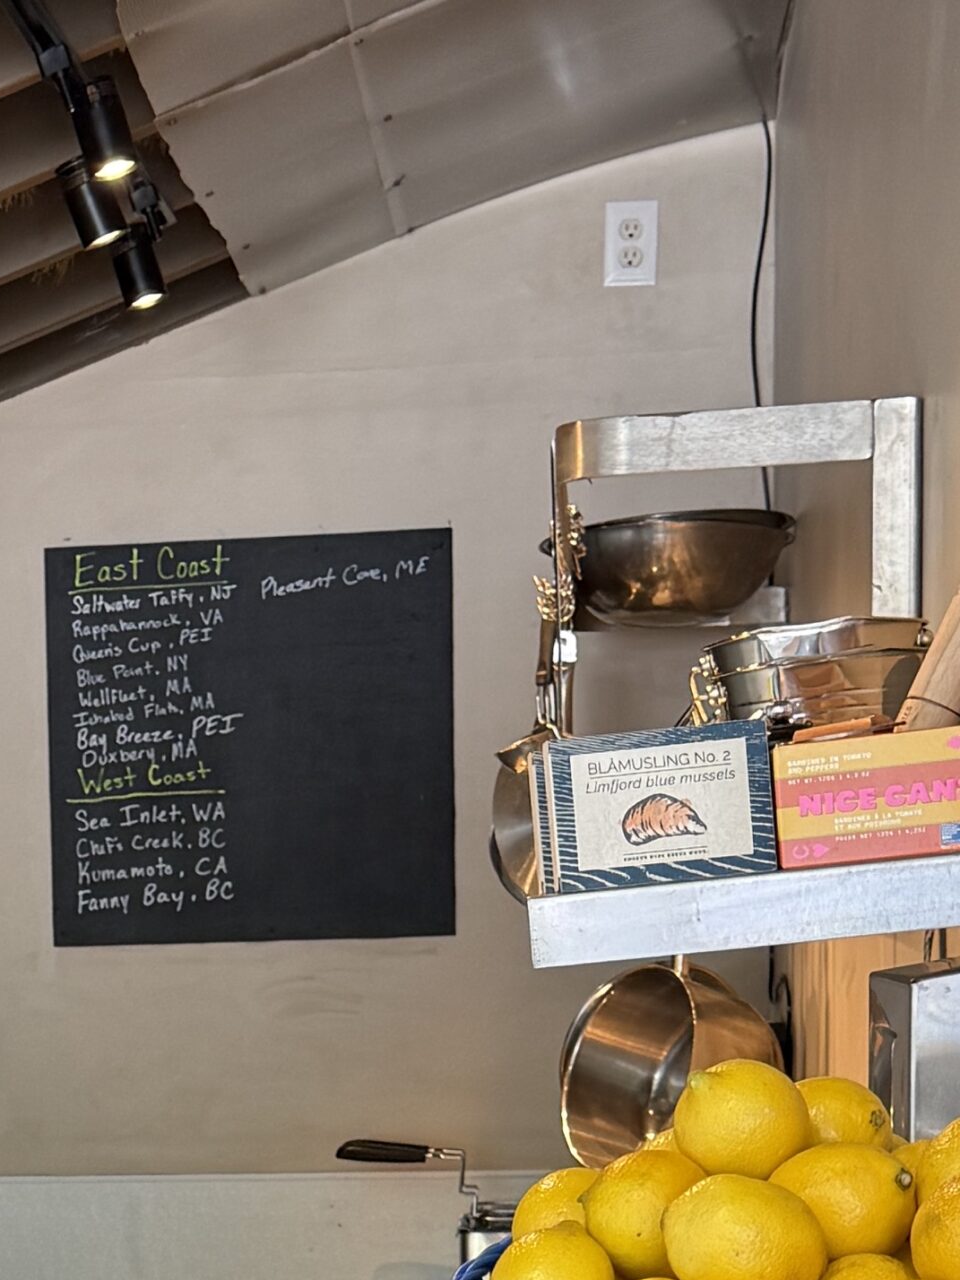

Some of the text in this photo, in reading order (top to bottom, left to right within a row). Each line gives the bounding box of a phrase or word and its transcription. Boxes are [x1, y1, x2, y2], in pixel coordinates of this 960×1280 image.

[74, 544, 231, 587] East Coast
[395, 556, 430, 580] ME
[210, 584, 238, 601] NJ
[200, 608, 224, 626] VA
[179, 628, 213, 646] PEI
[76, 668, 106, 687] Blue
[166, 654, 189, 672] NY
[166, 676, 192, 697] MA
[190, 692, 215, 711] MA
[77, 727, 107, 755] Bay
[191, 713, 244, 739] PEI
[171, 739, 198, 762] MA
[587, 752, 690, 776] BLÅMUSLING
[723, 750, 732, 762] 2
[77, 761, 212, 795] West Coast
[586, 768, 736, 794] Limfjord blue mussels
[798, 787, 878, 818] NICE
[75, 809, 111, 832] Sea
[192, 801, 226, 822] WA
[198, 827, 226, 849] BC
[195, 855, 228, 876] CA
[77, 889, 130, 915] Fanny
[205, 878, 235, 901] BC
